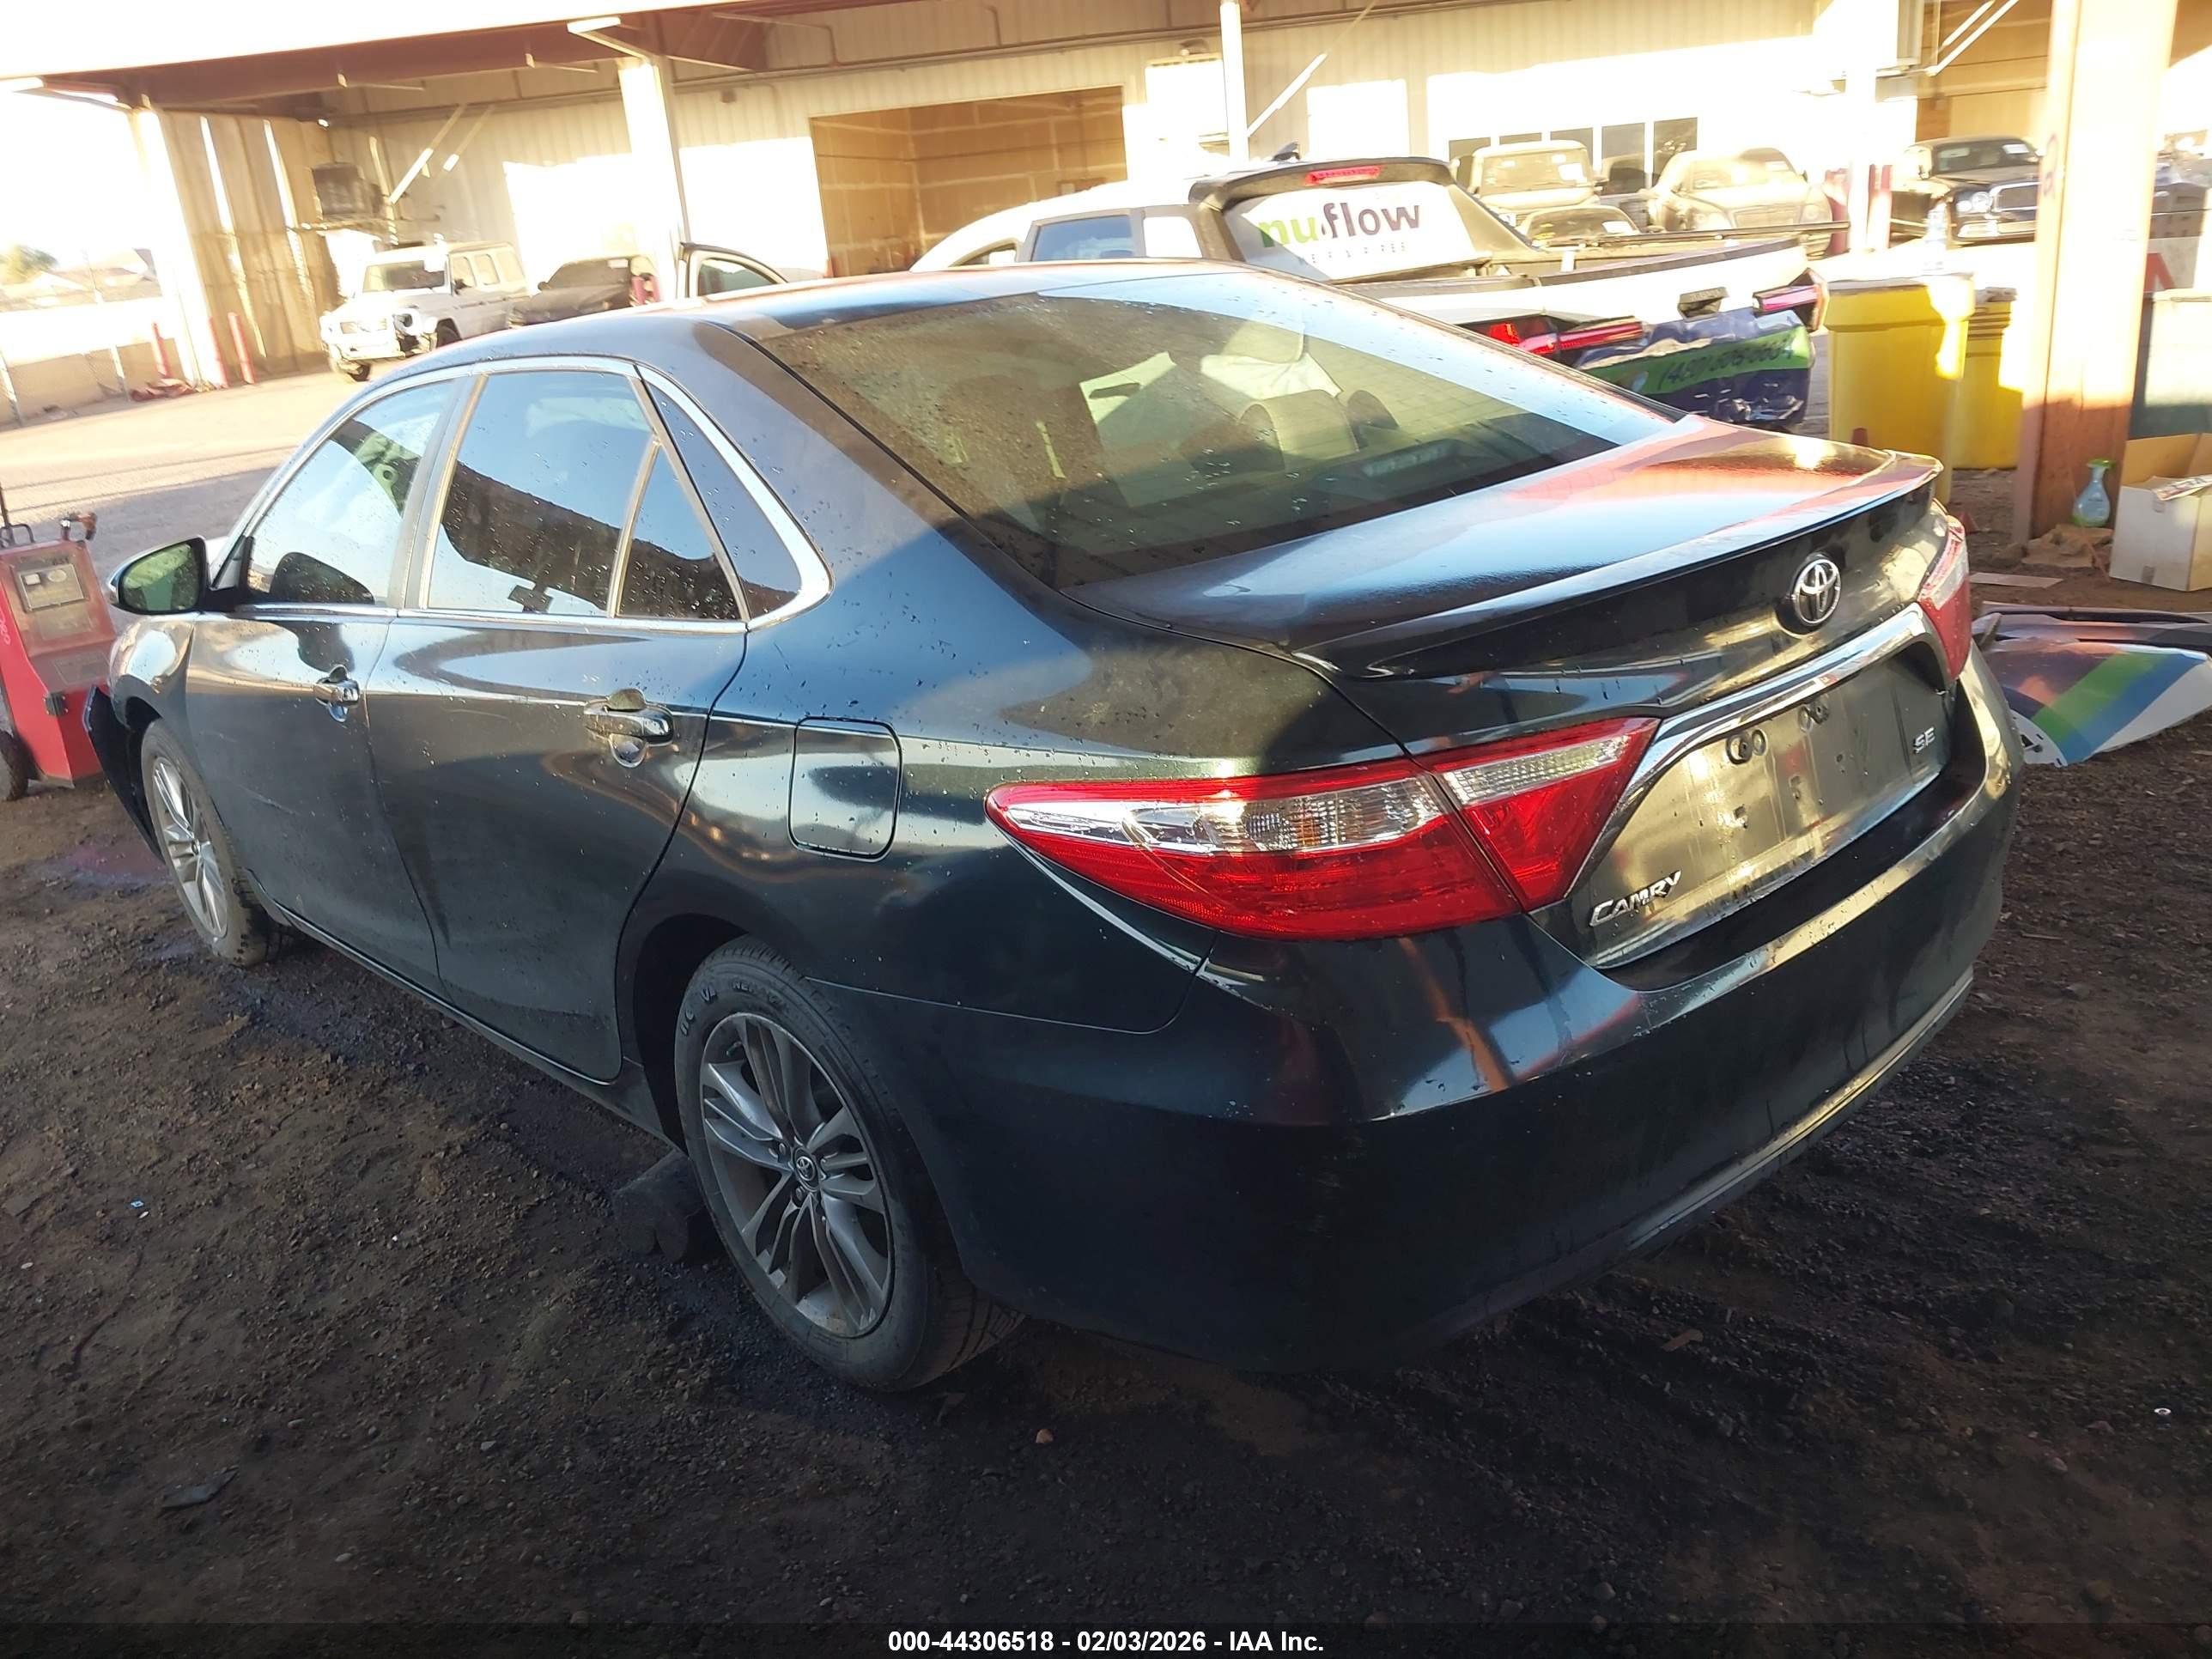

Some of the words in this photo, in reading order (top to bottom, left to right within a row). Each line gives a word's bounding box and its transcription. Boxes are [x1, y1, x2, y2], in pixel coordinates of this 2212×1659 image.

[1259, 202, 1420, 248] nuflow
[1913, 726, 1936, 754] SE
[1589, 869, 1682, 927] CAMRY
